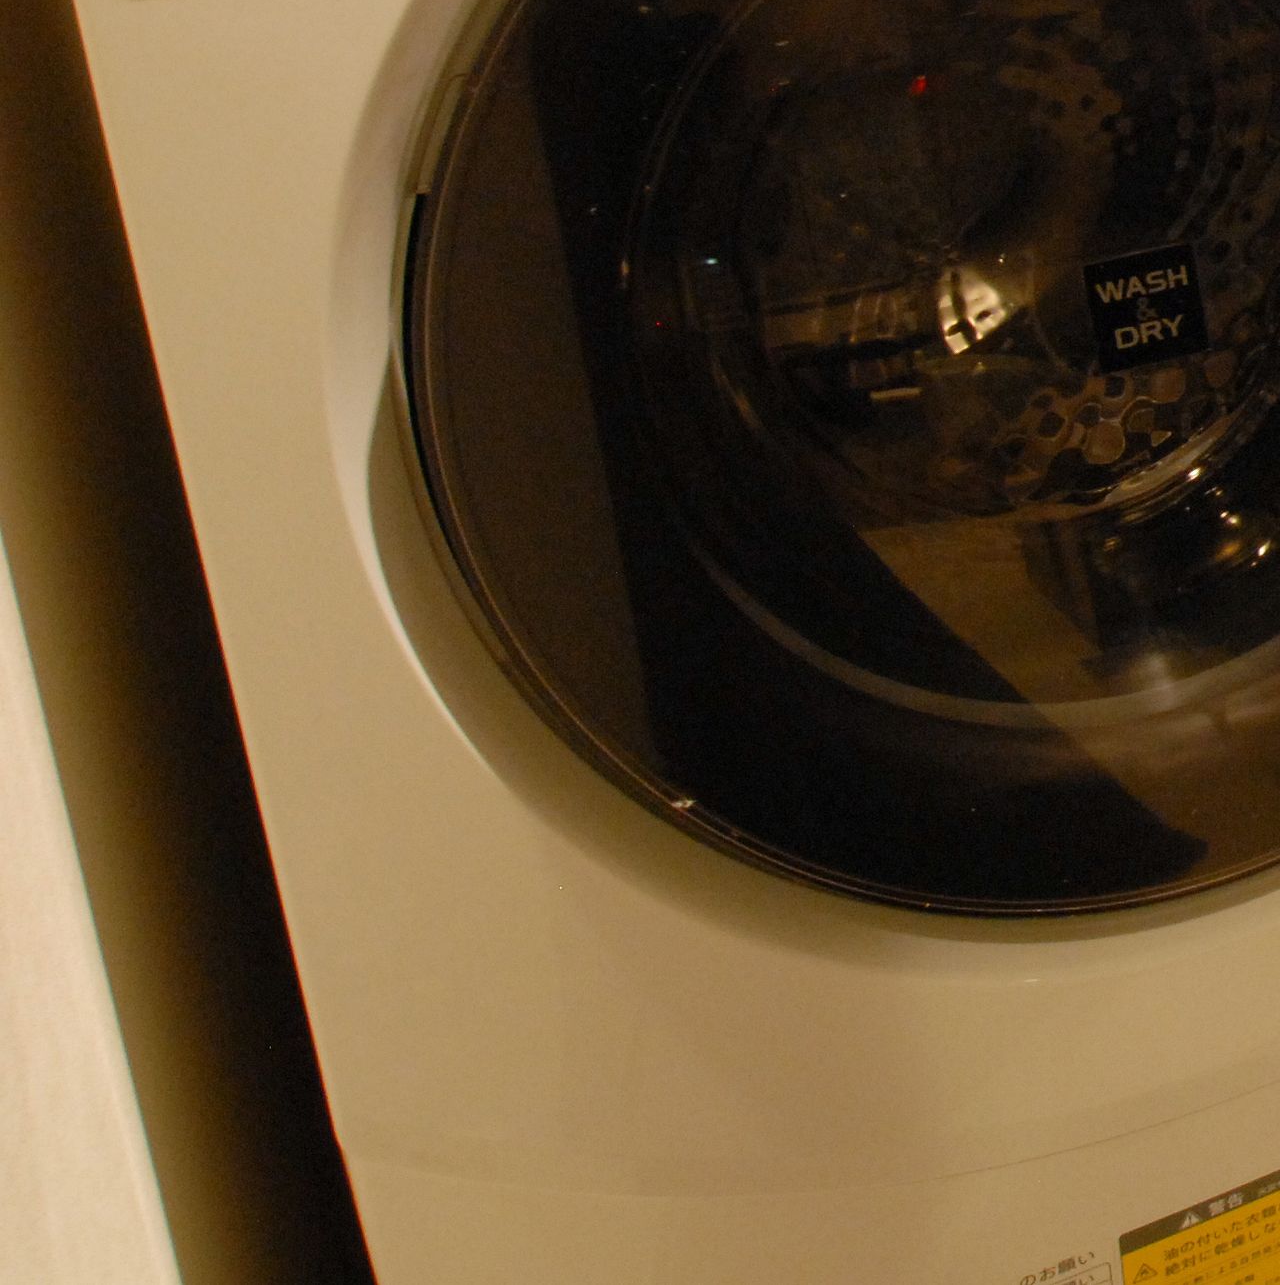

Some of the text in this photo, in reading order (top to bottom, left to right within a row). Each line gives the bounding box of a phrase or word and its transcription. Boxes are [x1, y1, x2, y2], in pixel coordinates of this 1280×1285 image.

[1095, 265, 1189, 303] WASH
[1137, 297, 1157, 320] &
[1114, 314, 1184, 349] DRY
